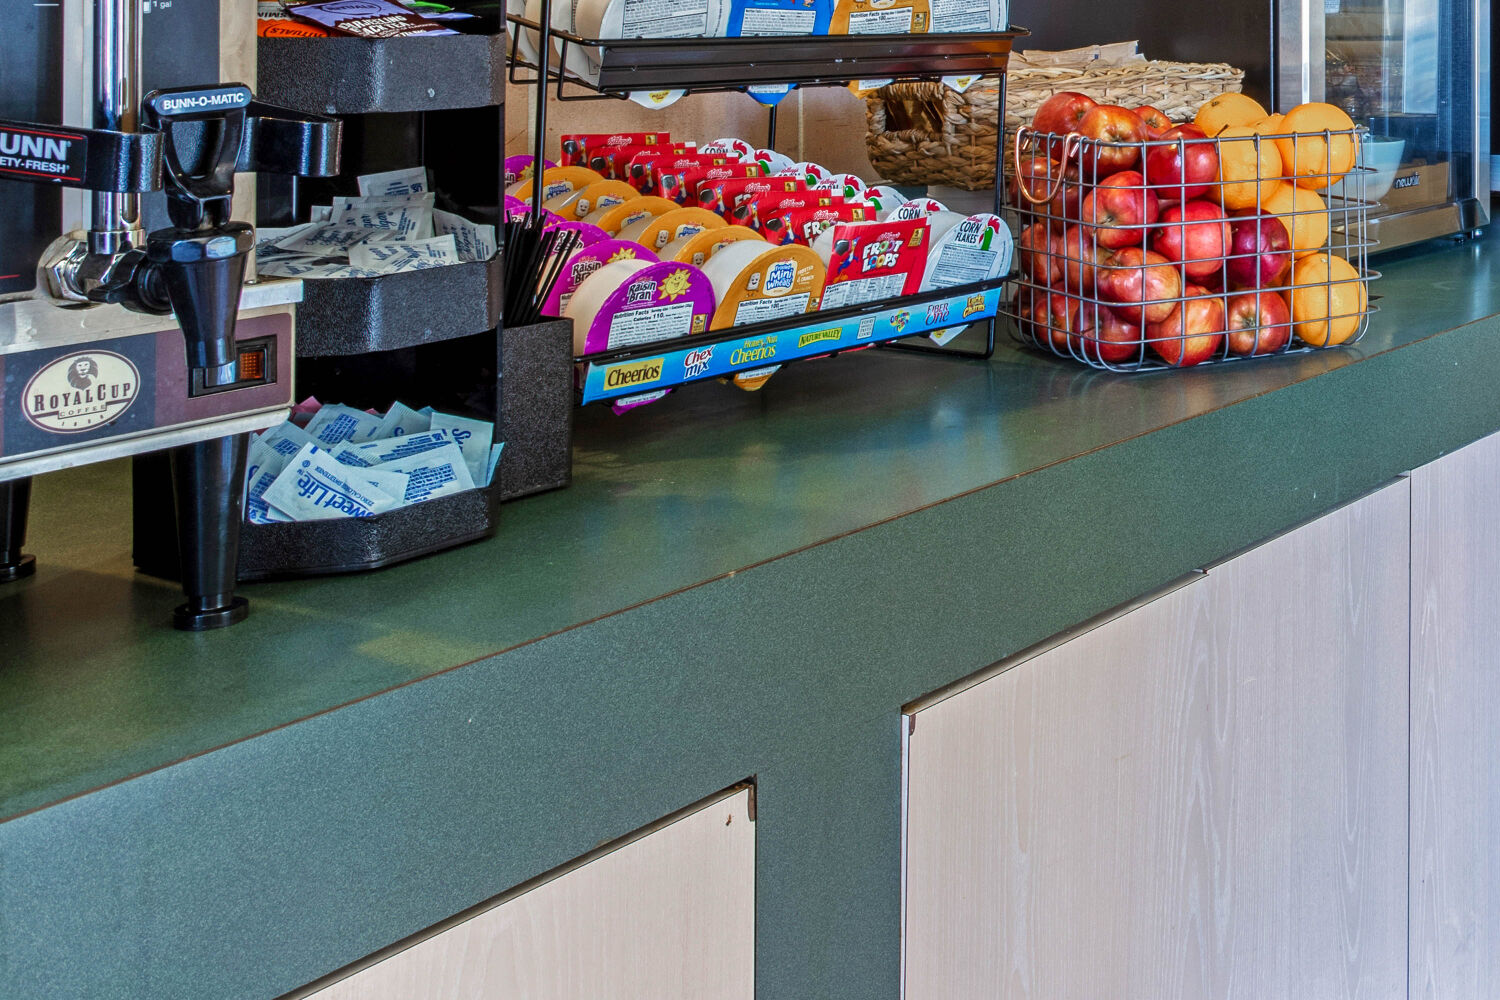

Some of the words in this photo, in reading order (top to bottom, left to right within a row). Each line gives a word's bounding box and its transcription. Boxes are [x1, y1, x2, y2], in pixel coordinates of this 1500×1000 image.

[160, 1, 173, 10] gal
[163, 92, 245, 111] BUNN-O-MATIC
[0, 131, 68, 162] UNN
[0, 158, 65, 174] ETY-FRESH
[898, 207, 921, 220] CORN
[959, 220, 983, 233] CORN
[955, 232, 978, 245] FLAKES
[862, 239, 905, 260] FROOT
[572, 261, 602, 277] Raisin
[862, 252, 900, 274] LOOPS
[574, 273, 593, 286] Bra
[770, 268, 794, 281] Mini
[628, 281, 657, 295] Raisin
[628, 290, 653, 305] Bran
[927, 302, 950, 314] FIBER
[800, 332, 822, 346] NATURE
[823, 328, 842, 339] VALLEY
[685, 346, 713, 366] Chex
[730, 345, 777, 366] Cheerios
[608, 364, 660, 387] Cheerios
[685, 361, 709, 379] mix
[296, 474, 327, 507] Life
